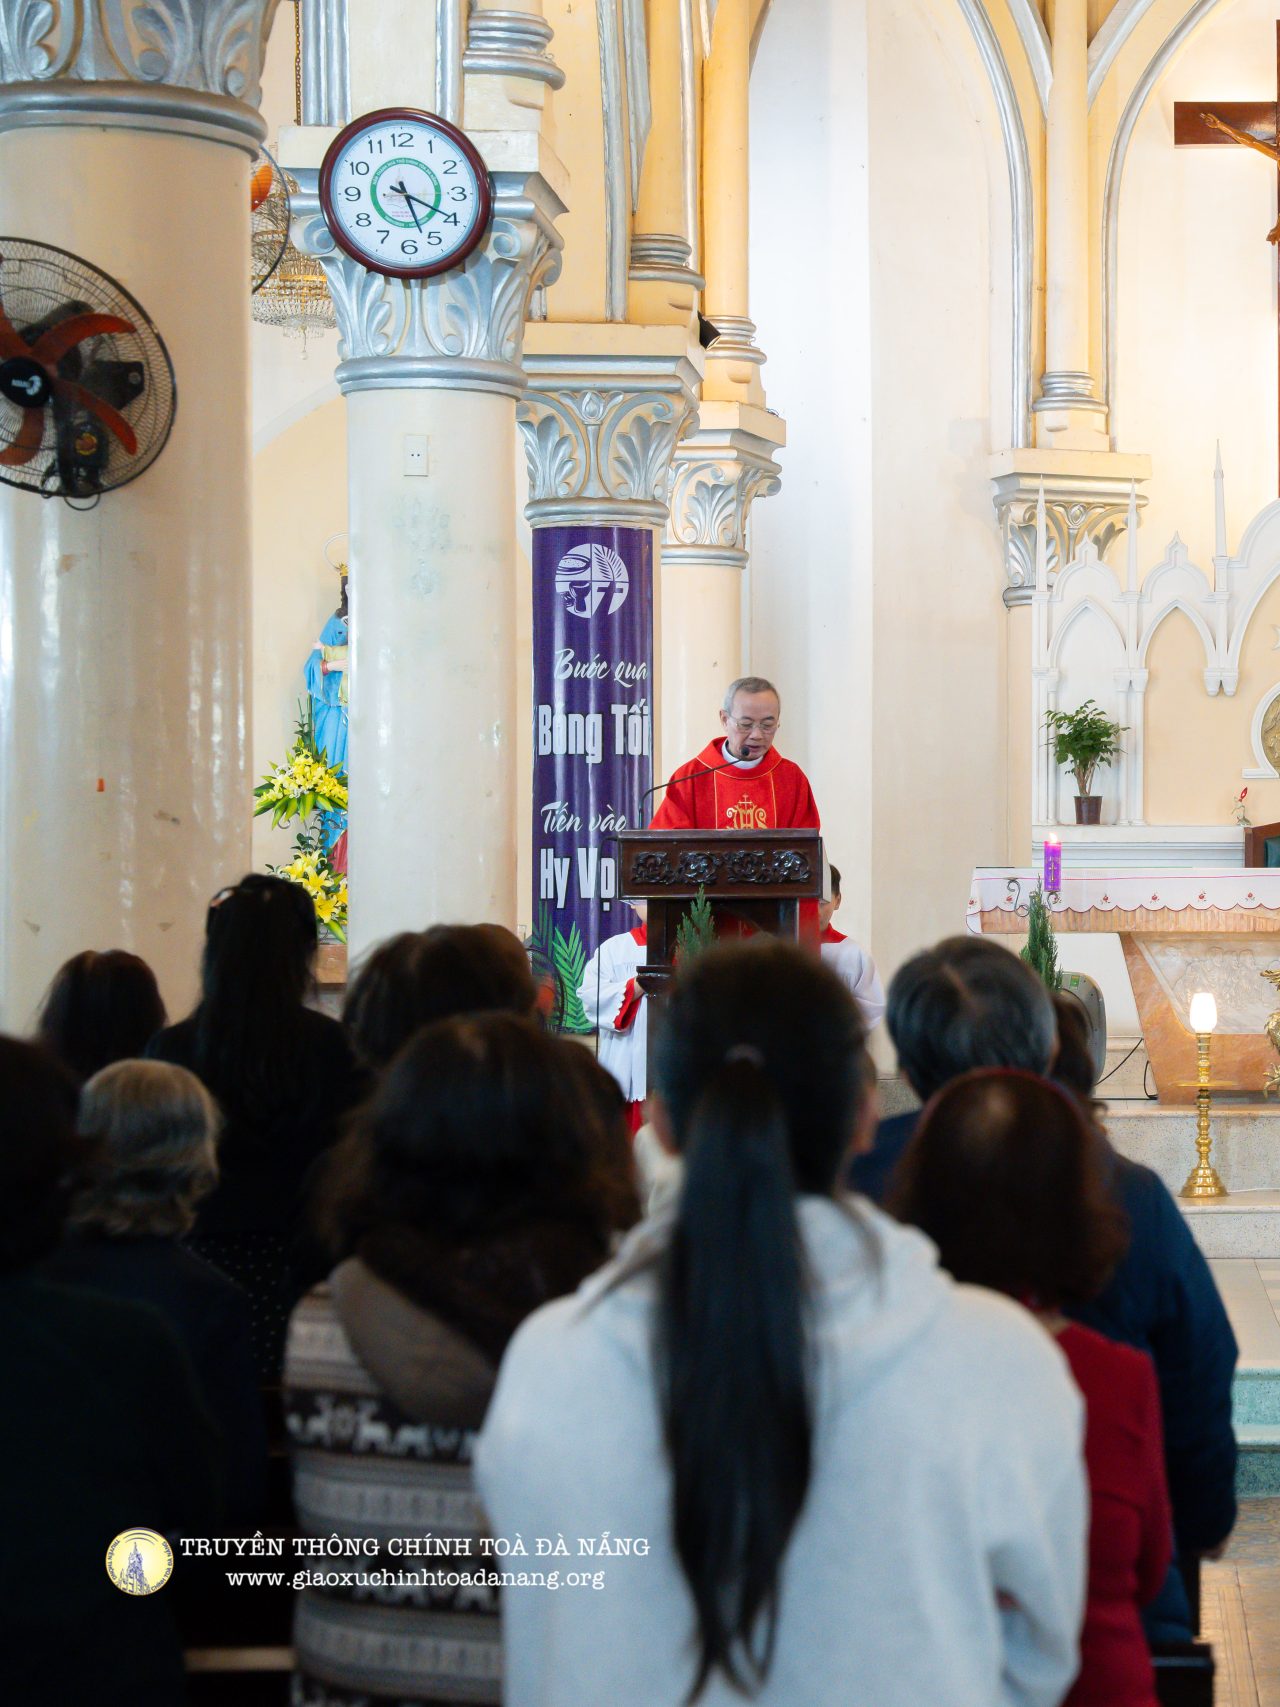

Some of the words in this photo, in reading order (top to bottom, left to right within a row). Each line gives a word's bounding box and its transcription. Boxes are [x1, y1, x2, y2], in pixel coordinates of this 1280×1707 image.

[368, 140, 383, 154] 11
[391, 133, 414, 147] 12
[428, 140, 433, 153] 1
[350, 161, 370, 175] 10
[442, 160, 458, 174] 2
[344, 187, 361, 201] 9
[451, 187, 467, 201] 3
[356, 213, 371, 227] 8
[443, 212, 460, 226] 4
[377, 230, 390, 244] 7
[427, 232, 442, 245] 5
[401, 239, 418, 254] 6
[553, 648, 610, 680] Bước
[614, 660, 648, 688] qua
[539, 700, 602, 763] Bóng
[611, 698, 648, 755] Tối
[541, 801, 583, 834] Tiến
[588, 804, 627, 832] vào
[540, 848, 570, 908] Hy
[577, 847, 615, 911] Vọ
